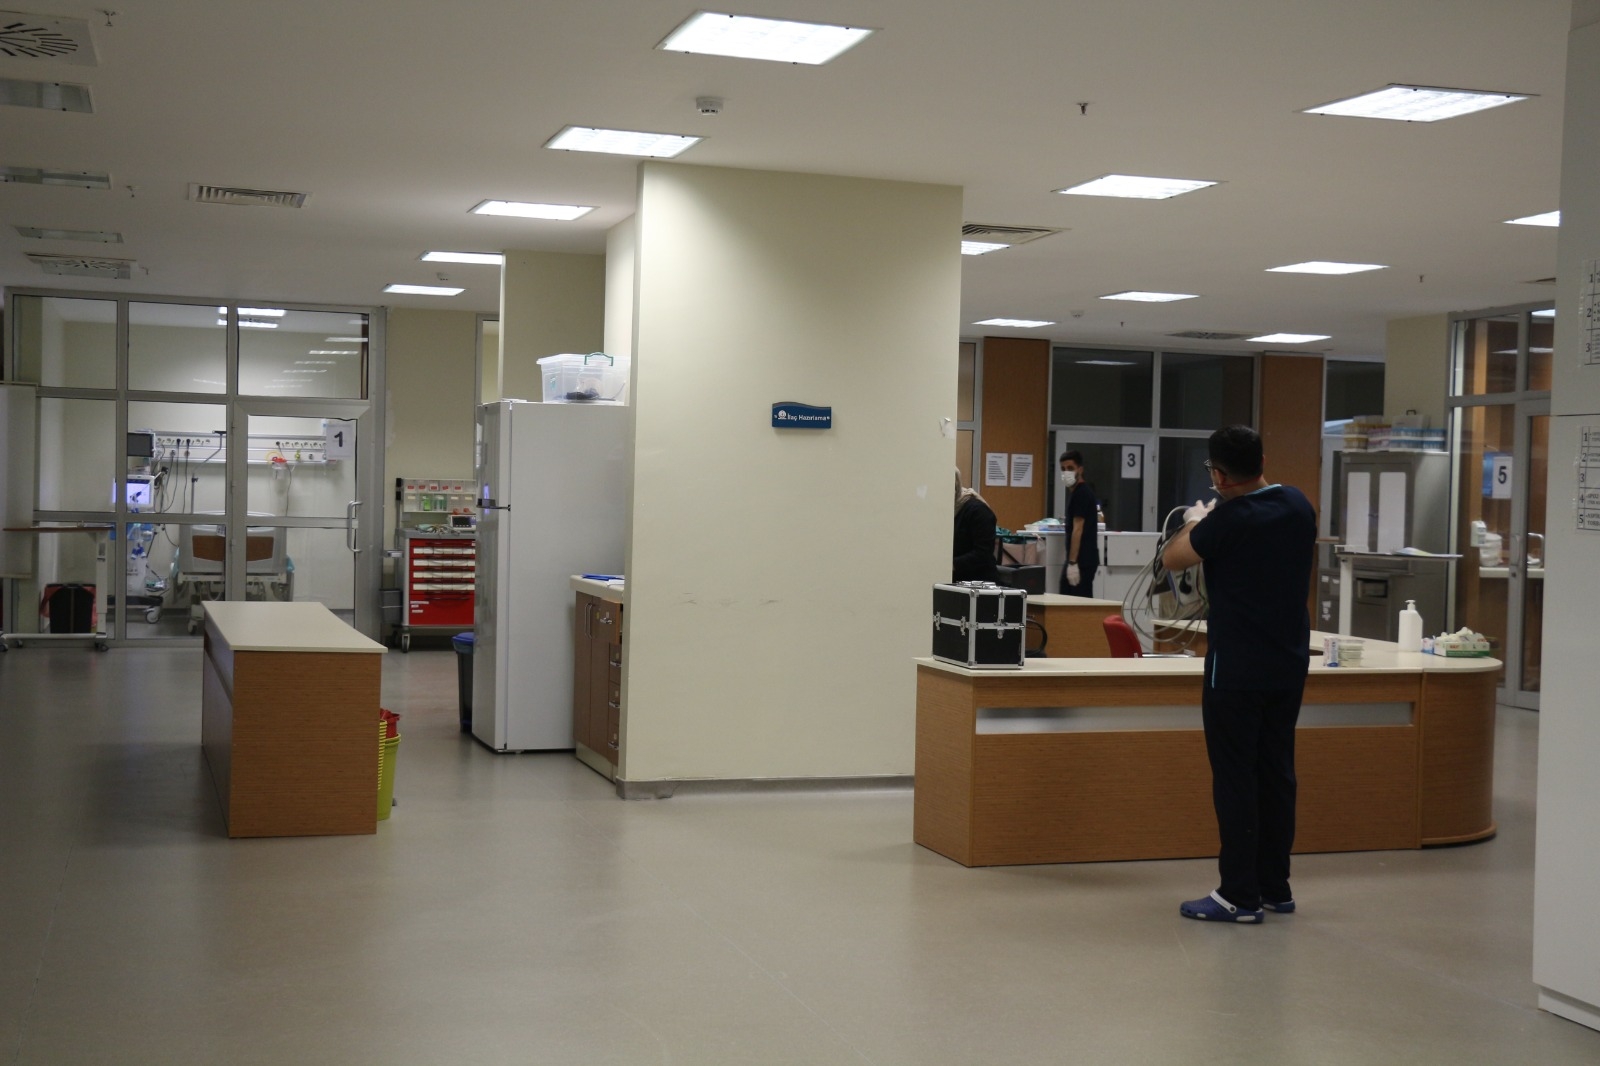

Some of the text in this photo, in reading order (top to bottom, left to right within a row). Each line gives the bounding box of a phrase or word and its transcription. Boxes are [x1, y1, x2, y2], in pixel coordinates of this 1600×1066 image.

[1586, 307, 1592, 318] 2
[1585, 342, 1591, 352] 3
[334, 431, 343, 447] 1
[1127, 453, 1136, 467] 3
[1498, 465, 1507, 484] 5
[1579, 473, 1585, 482] 3
[1579, 494, 1585, 503] 4
[1578, 514, 1584, 523] 5
